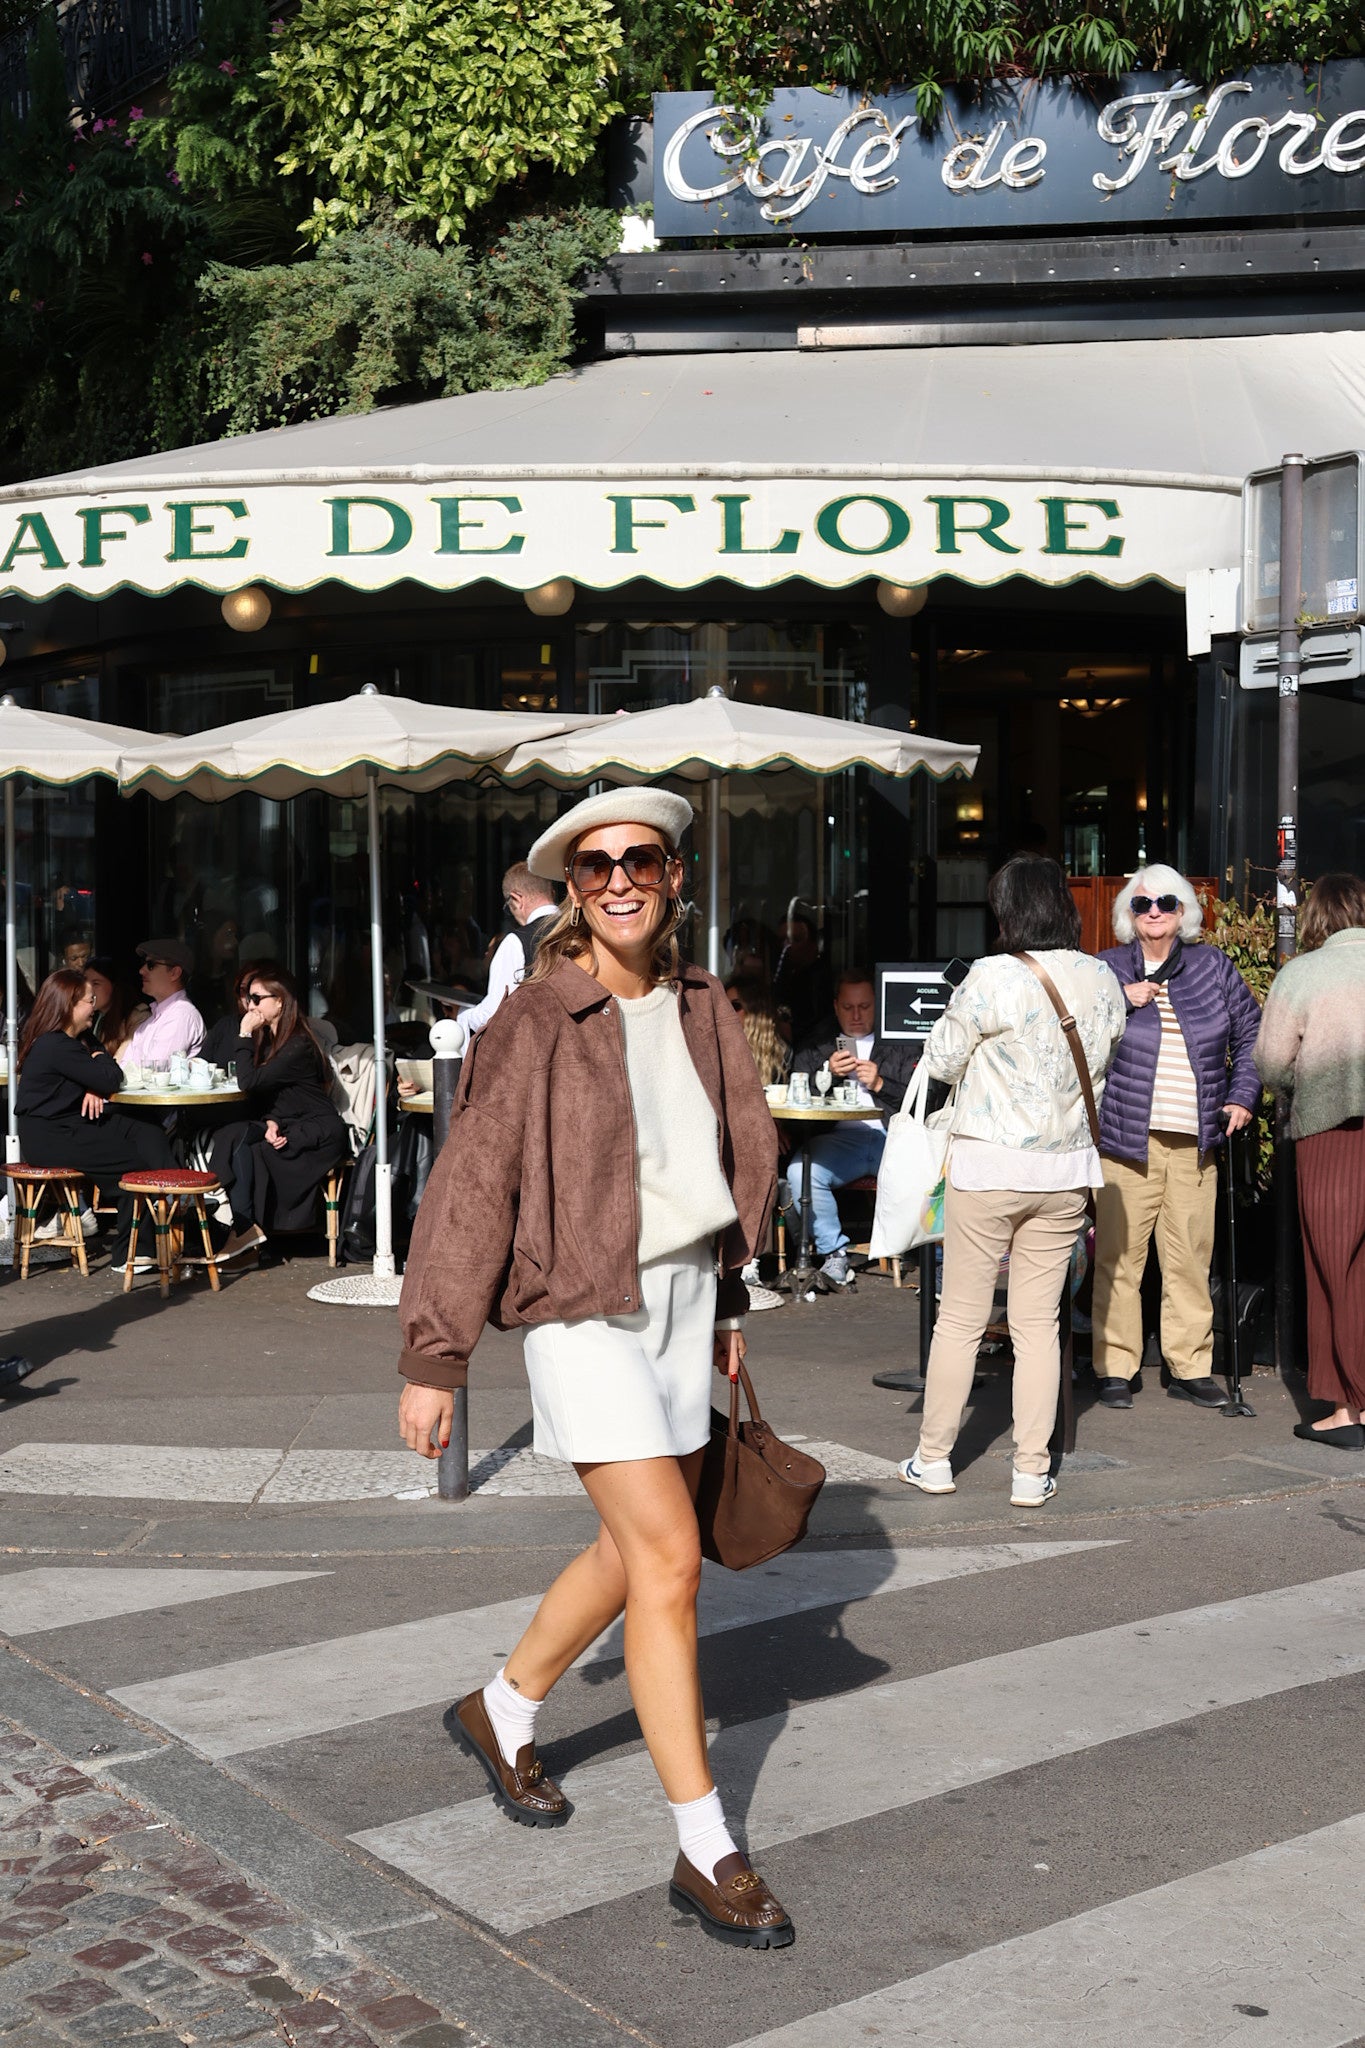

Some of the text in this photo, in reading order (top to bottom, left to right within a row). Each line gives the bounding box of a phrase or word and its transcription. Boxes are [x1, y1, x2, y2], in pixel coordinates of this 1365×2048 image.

[941, 120, 1047, 190] de
[1092, 79, 1365, 190] Flore
[0, 493, 1127, 573] AFE DE FLORE
